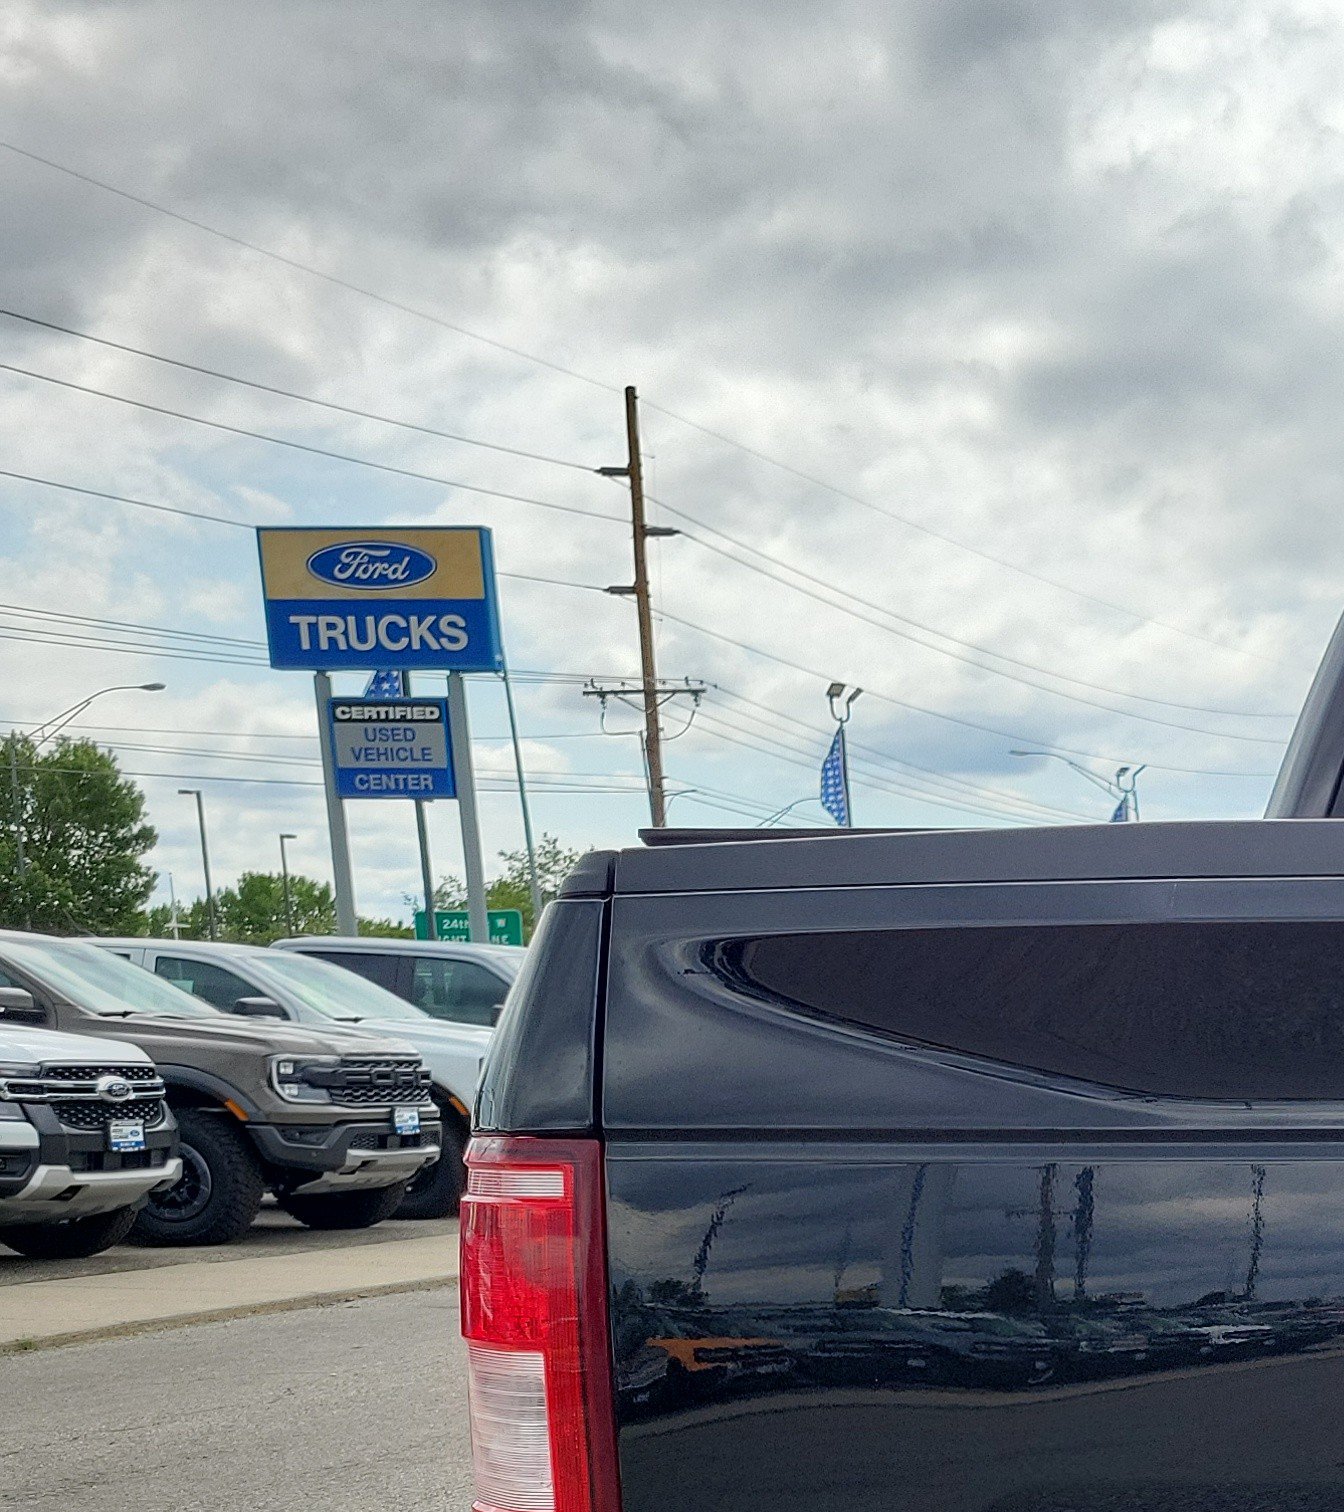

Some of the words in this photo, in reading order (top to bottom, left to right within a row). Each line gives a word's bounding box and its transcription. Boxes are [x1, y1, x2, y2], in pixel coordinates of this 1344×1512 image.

[333, 547, 410, 581] Ford
[289, 614, 469, 652] TRUCKS
[334, 705, 440, 721] CERTIFIED
[364, 726, 416, 742] USED
[351, 746, 433, 762] VEHICLE
[354, 773, 434, 791] CENTER
